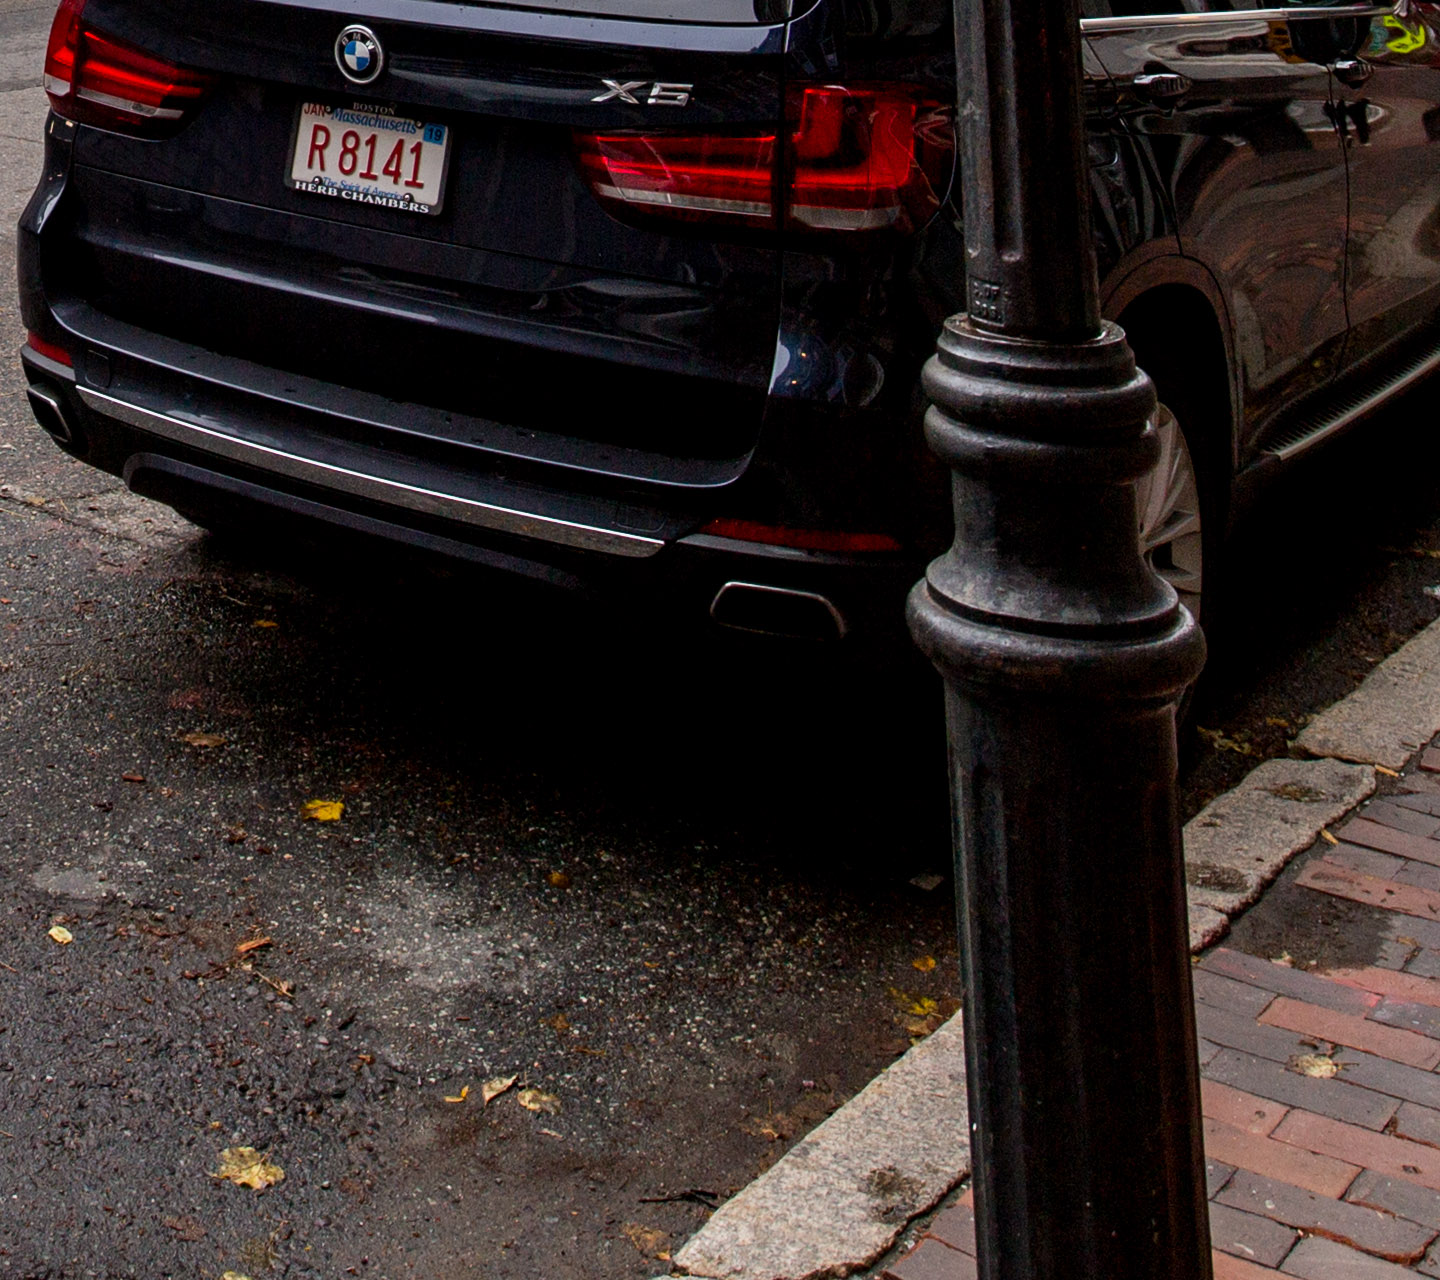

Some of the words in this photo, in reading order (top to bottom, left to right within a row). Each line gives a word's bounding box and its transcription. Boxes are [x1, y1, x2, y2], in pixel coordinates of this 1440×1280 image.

[590, 79, 694, 107] X5
[304, 102, 326, 117] JAN
[352, 101, 396, 116] BOSTON
[331, 107, 418, 135] Massachusetts
[428, 127, 443, 141] 19
[307, 124, 331, 172] R
[338, 130, 424, 189] 8141
[322, 176, 337, 188] The
[295, 181, 338, 198] HERB
[341, 189, 430, 214] CHAMBERS
